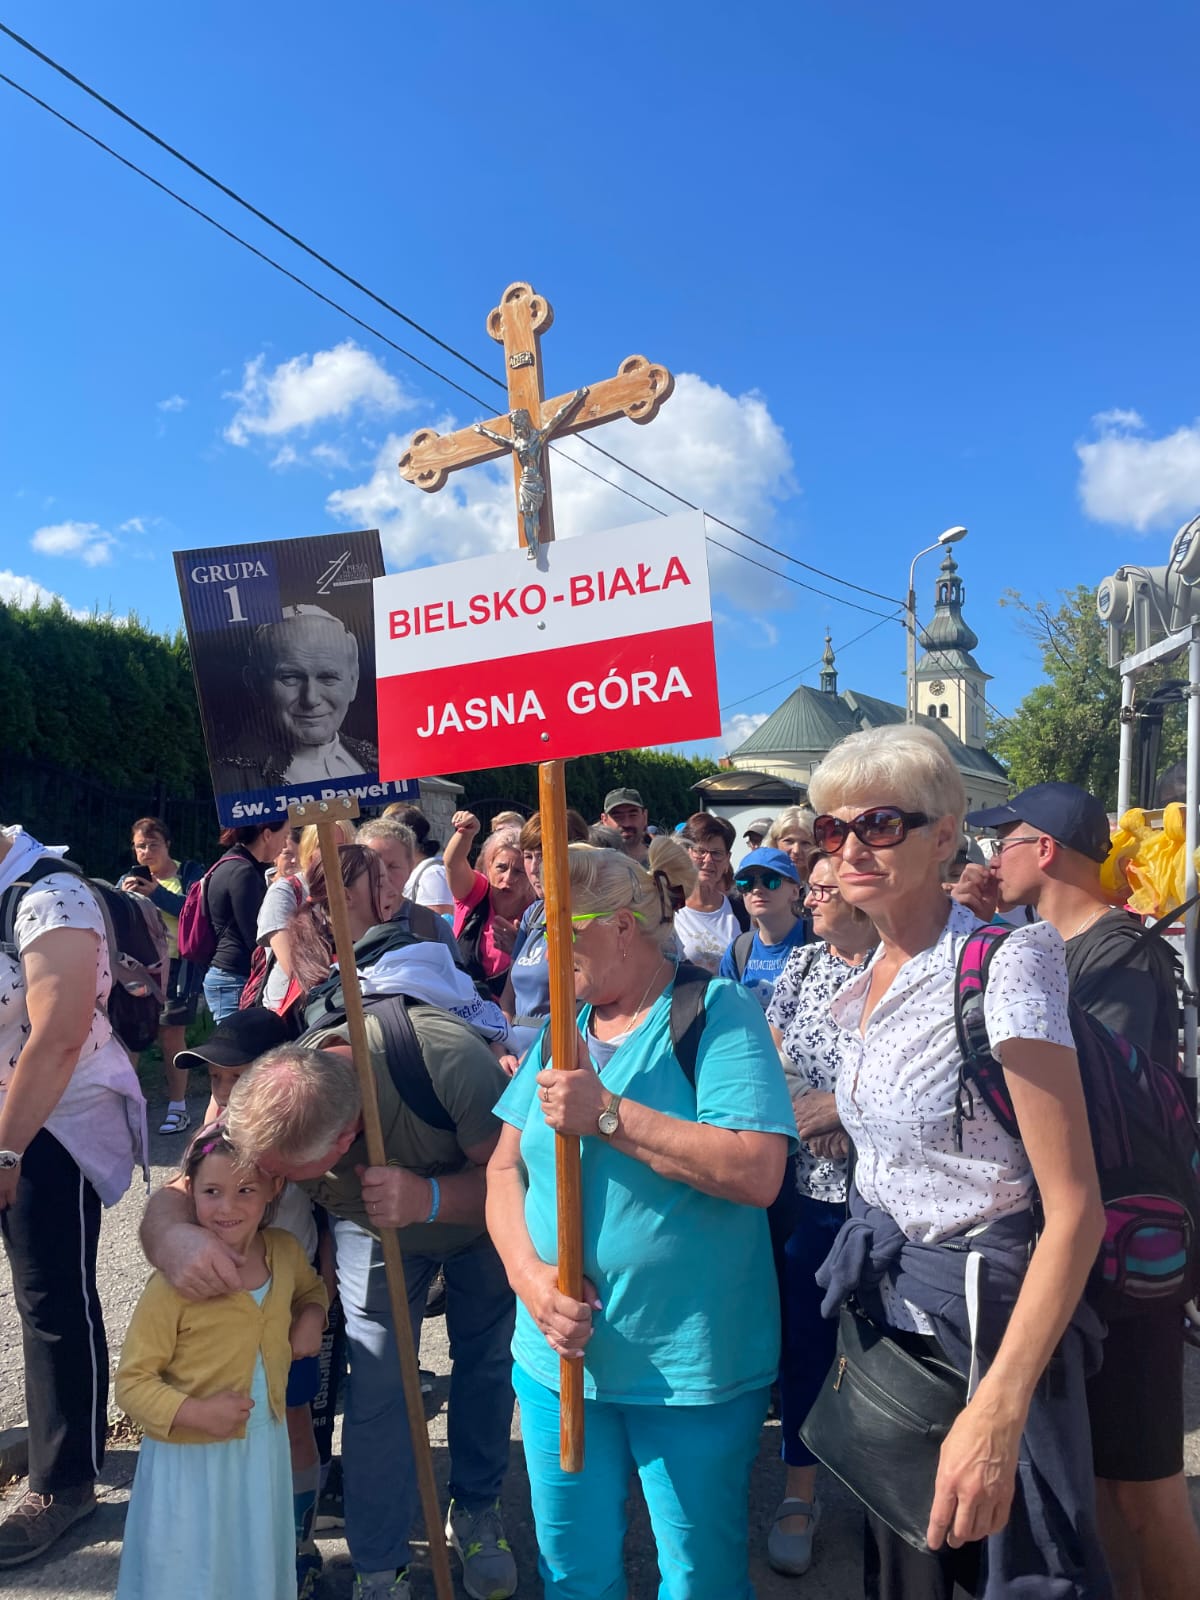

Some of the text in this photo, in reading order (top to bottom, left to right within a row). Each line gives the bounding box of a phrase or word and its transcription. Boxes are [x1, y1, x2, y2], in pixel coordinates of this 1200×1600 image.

[191, 560, 269, 583] GRUPA
[223, 585, 248, 622] 1
[389, 556, 691, 640] BIELSKO-BIAŁA
[416, 666, 693, 738] JASNA GÓRA
[231, 800, 271, 819] św.
